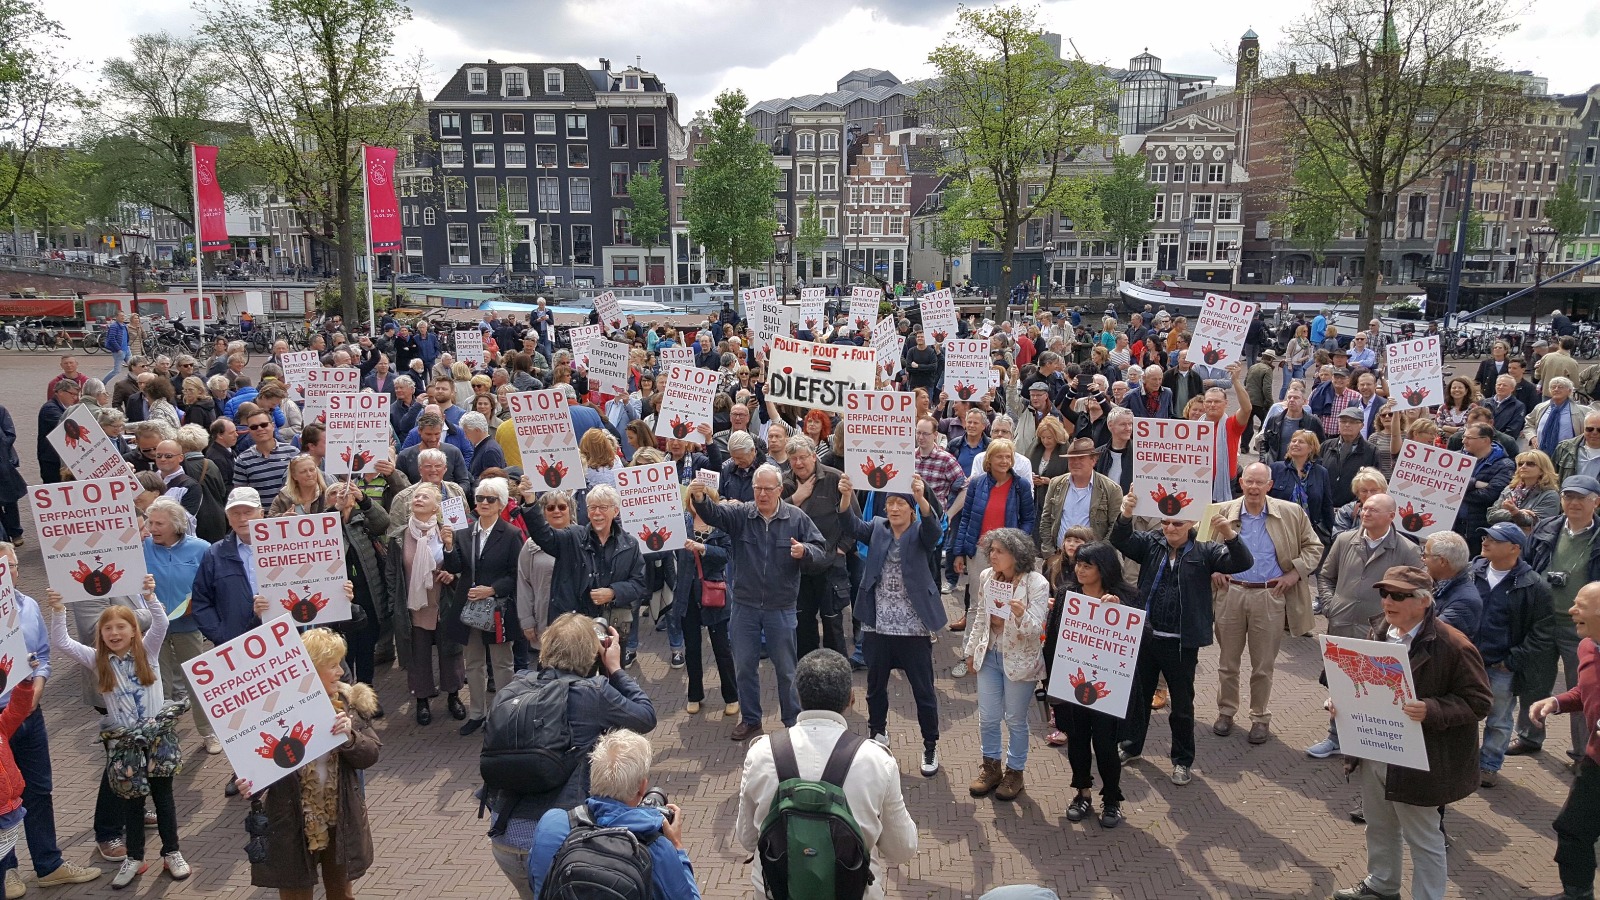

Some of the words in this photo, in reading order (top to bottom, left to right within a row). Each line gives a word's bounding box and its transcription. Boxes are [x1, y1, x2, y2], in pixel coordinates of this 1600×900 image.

[595, 293, 612, 305] STOP
[745, 288, 774, 300] STOP
[854, 289, 879, 297] STOP
[922, 300, 949, 310] STOP
[1207, 296, 1252, 316] STOP
[764, 316, 781, 325] BULL
[1201, 317, 1242, 332] GEMEENTE
[1203, 310, 1232, 321] ERFPACHT
[1234, 317, 1248, 325] PLAN
[572, 326, 598, 337] STOP
[764, 324, 780, 332] SHIT
[874, 318, 892, 338] STOP
[663, 350, 692, 358] STOP
[813, 346, 839, 358] FOUT
[852, 349, 875, 361] FOUT
[948, 342, 987, 352] STOP
[1390, 339, 1436, 357] STOP
[283, 353, 316, 363] STOP
[592, 349, 626, 361] ERFPACHT
[1390, 355, 1420, 364] ERFPACHT
[600, 359, 617, 367] PLAN
[1390, 360, 1433, 373] GEMEENTE
[308, 371, 357, 381] STOP
[590, 367, 626, 379] GEMEENTE
[671, 367, 716, 386] STOP
[669, 381, 698, 391] ERFPACHT
[330, 396, 387, 409] STOP
[511, 392, 563, 412] STOP
[667, 390, 708, 404] GEMEENTE
[847, 394, 911, 411] STOP
[515, 414, 548, 423] ERFPACHT
[848, 414, 888, 422] ERFPACHT
[518, 423, 565, 436] GEMEENTE
[847, 424, 905, 436] GEMEENTE
[1137, 421, 1209, 440] STOP
[1137, 441, 1183, 450] ERFPACHT
[1186, 444, 1208, 452] PLAN
[1136, 452, 1201, 464] GEMEENTE
[1404, 444, 1471, 471] STOP
[618, 466, 673, 486] STOP
[1400, 461, 1442, 476] ERFPACHT
[1444, 472, 1466, 483] PLAN
[1396, 470, 1456, 493] GEMEENTE
[35, 481, 126, 509] STOP
[621, 485, 656, 496] ERFPACHT
[658, 483, 676, 492] PLAN
[443, 498, 460, 506] STOP
[622, 493, 672, 507] GEMEENTE
[39, 508, 97, 522] ERFPACHT
[101, 504, 130, 516] PLAN
[42, 517, 124, 537] GEMEENTE
[255, 517, 336, 541] STOP
[257, 541, 309, 553] ERFPACHT
[313, 538, 338, 548] PLAN
[258, 551, 332, 567] GEMEENTE
[991, 580, 1011, 589] STOP
[1068, 598, 1140, 630] STOP
[1065, 618, 1110, 636] ERFPACHT
[1113, 631, 1136, 644] PLAN
[1062, 629, 1127, 656] GEMEENTE
[192, 622, 289, 685] STOP
[203, 663, 266, 702] ERFPACHT
[269, 646, 301, 669] PLAN
[211, 664, 301, 718] GEMEENTE
[226, 736, 238, 744] NIET
[239, 725, 256, 737] VEILIG
[260, 704, 294, 726] ONDUIDELIJK
[307, 690, 322, 701] DUUR
[1351, 713, 1364, 722] wij
[1365, 714, 1387, 725] laten
[1389, 720, 1404, 728] ons
[1357, 725, 1374, 735] niet
[1376, 728, 1402, 740] langer
[1360, 738, 1404, 752] uitmelken
